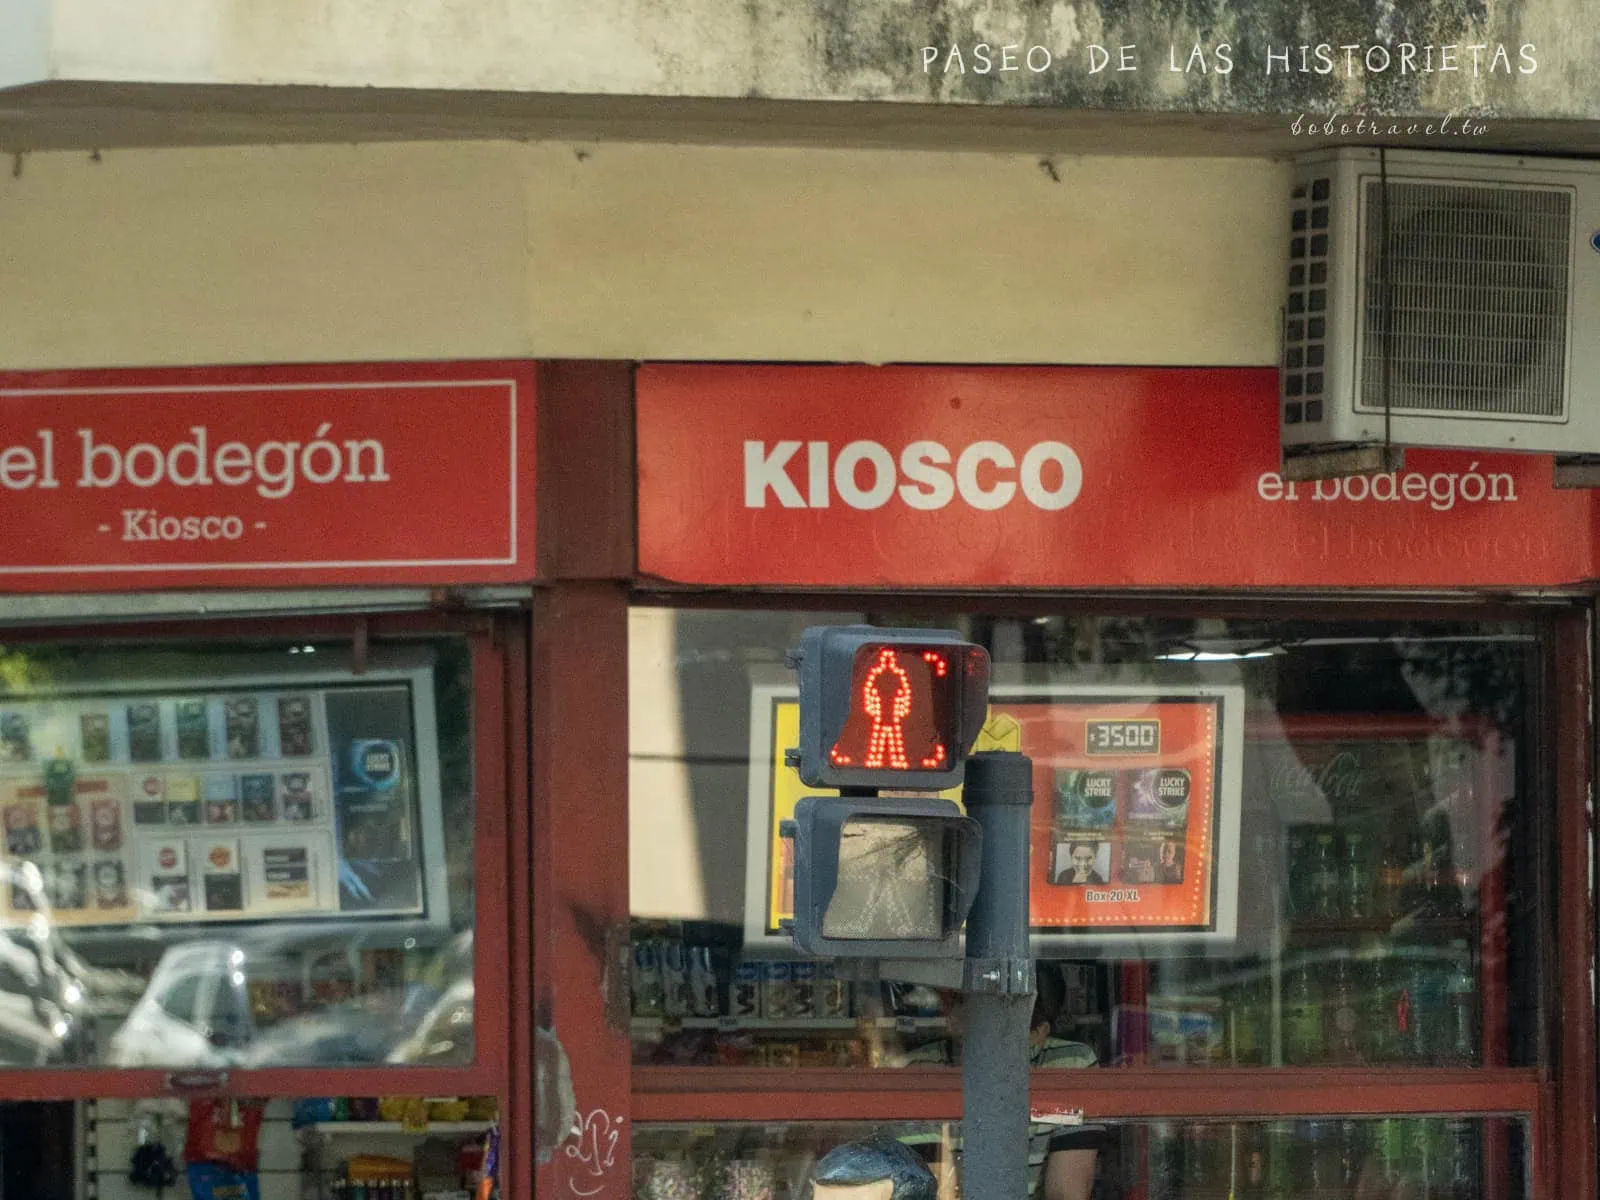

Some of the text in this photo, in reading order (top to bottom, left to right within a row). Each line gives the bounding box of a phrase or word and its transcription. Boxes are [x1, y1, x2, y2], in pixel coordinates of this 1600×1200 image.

[0, 422, 391, 500] el bodegón
[742, 439, 1084, 512] KIOSCO
[1311, 462, 1518, 511] bodegón
[121, 507, 244, 542] Kiosco
[1084, 787, 1112, 797] STRIKE
[1086, 777, 1112, 787] LUCKY
[1158, 787, 1185, 797] STRIKE
[1160, 777, 1185, 787] LUCKY
